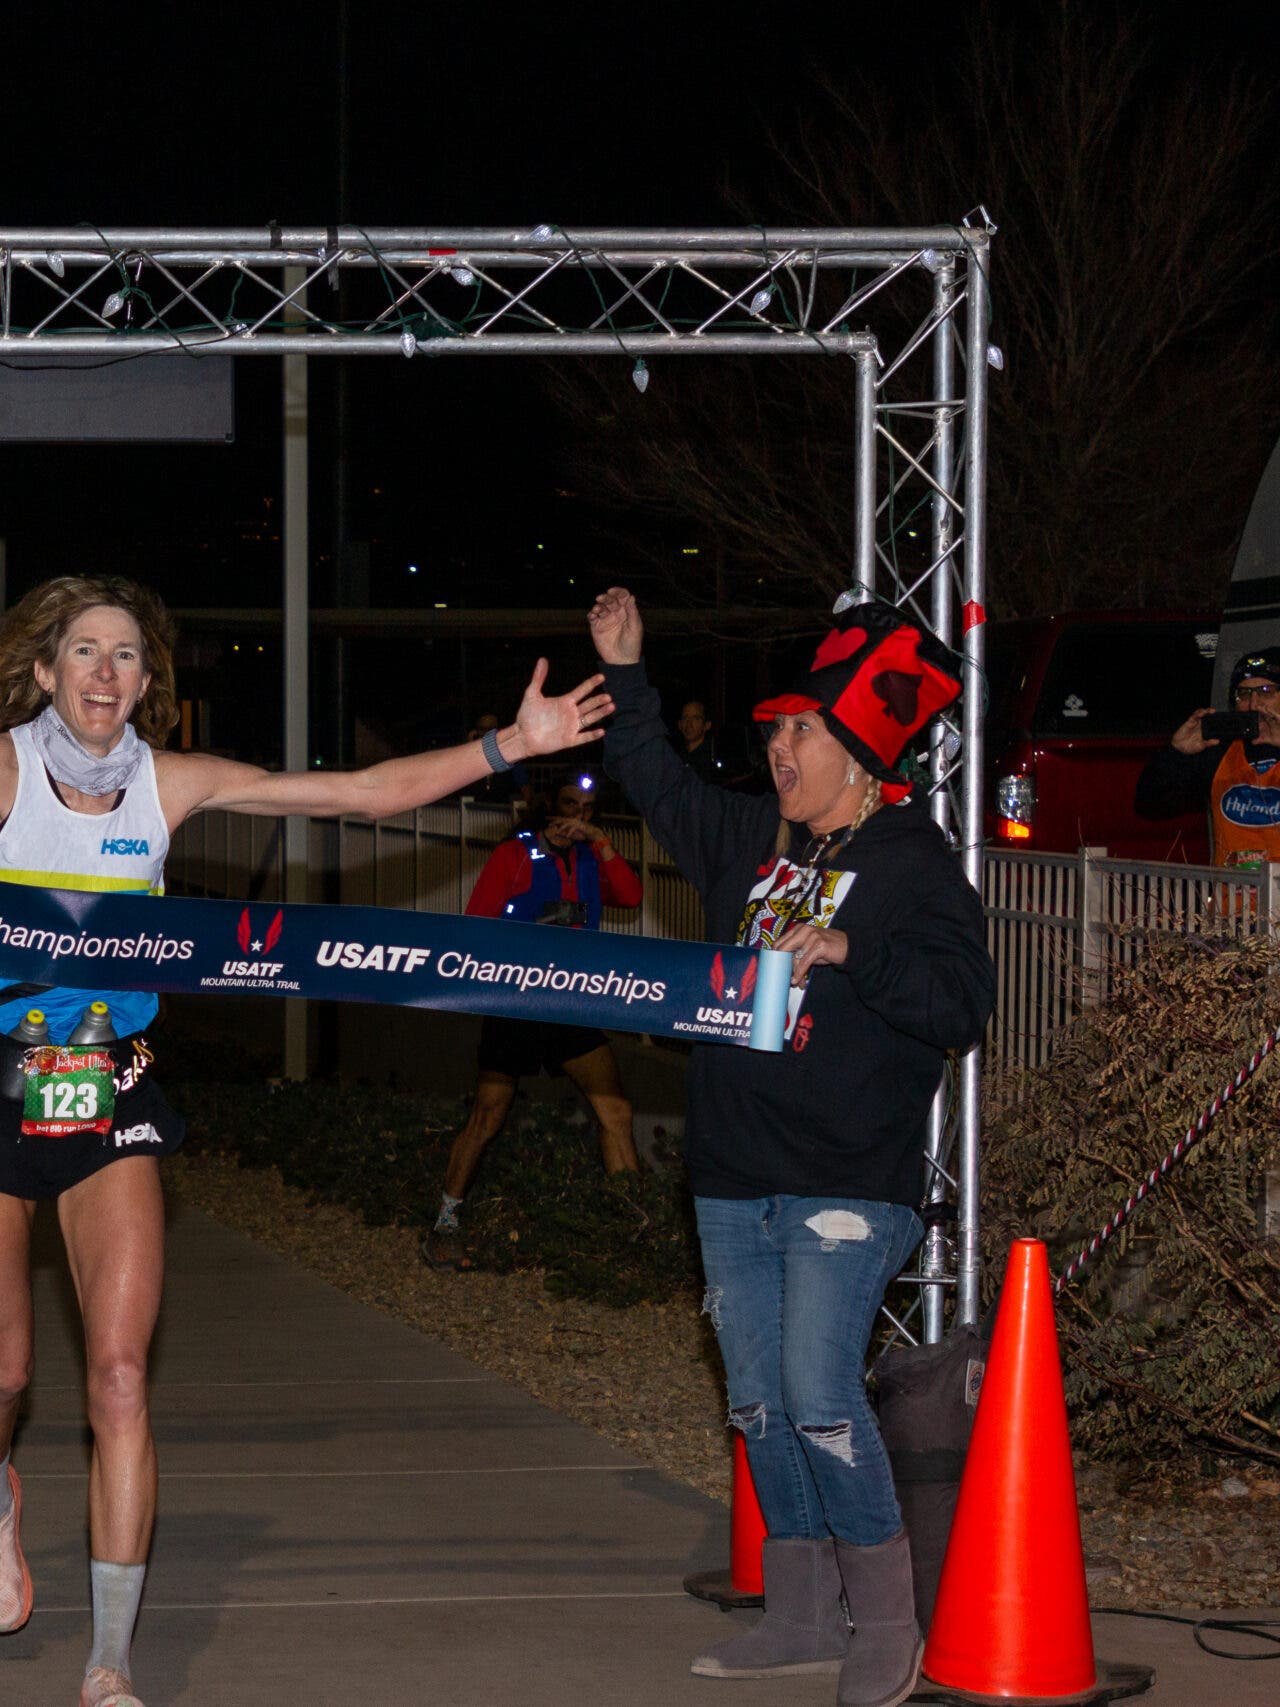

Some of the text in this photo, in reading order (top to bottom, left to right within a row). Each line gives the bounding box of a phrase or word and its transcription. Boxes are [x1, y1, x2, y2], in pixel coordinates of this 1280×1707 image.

[101, 838, 150, 856] HOKA
[222, 961, 284, 977] USATF
[316, 941, 666, 1004] USATF Championships
[200, 977, 301, 990] MOUNTAIN ULTRA TRAIL
[673, 1022, 720, 1035] MOUNTAIN
[40, 1083, 98, 1118] 123
